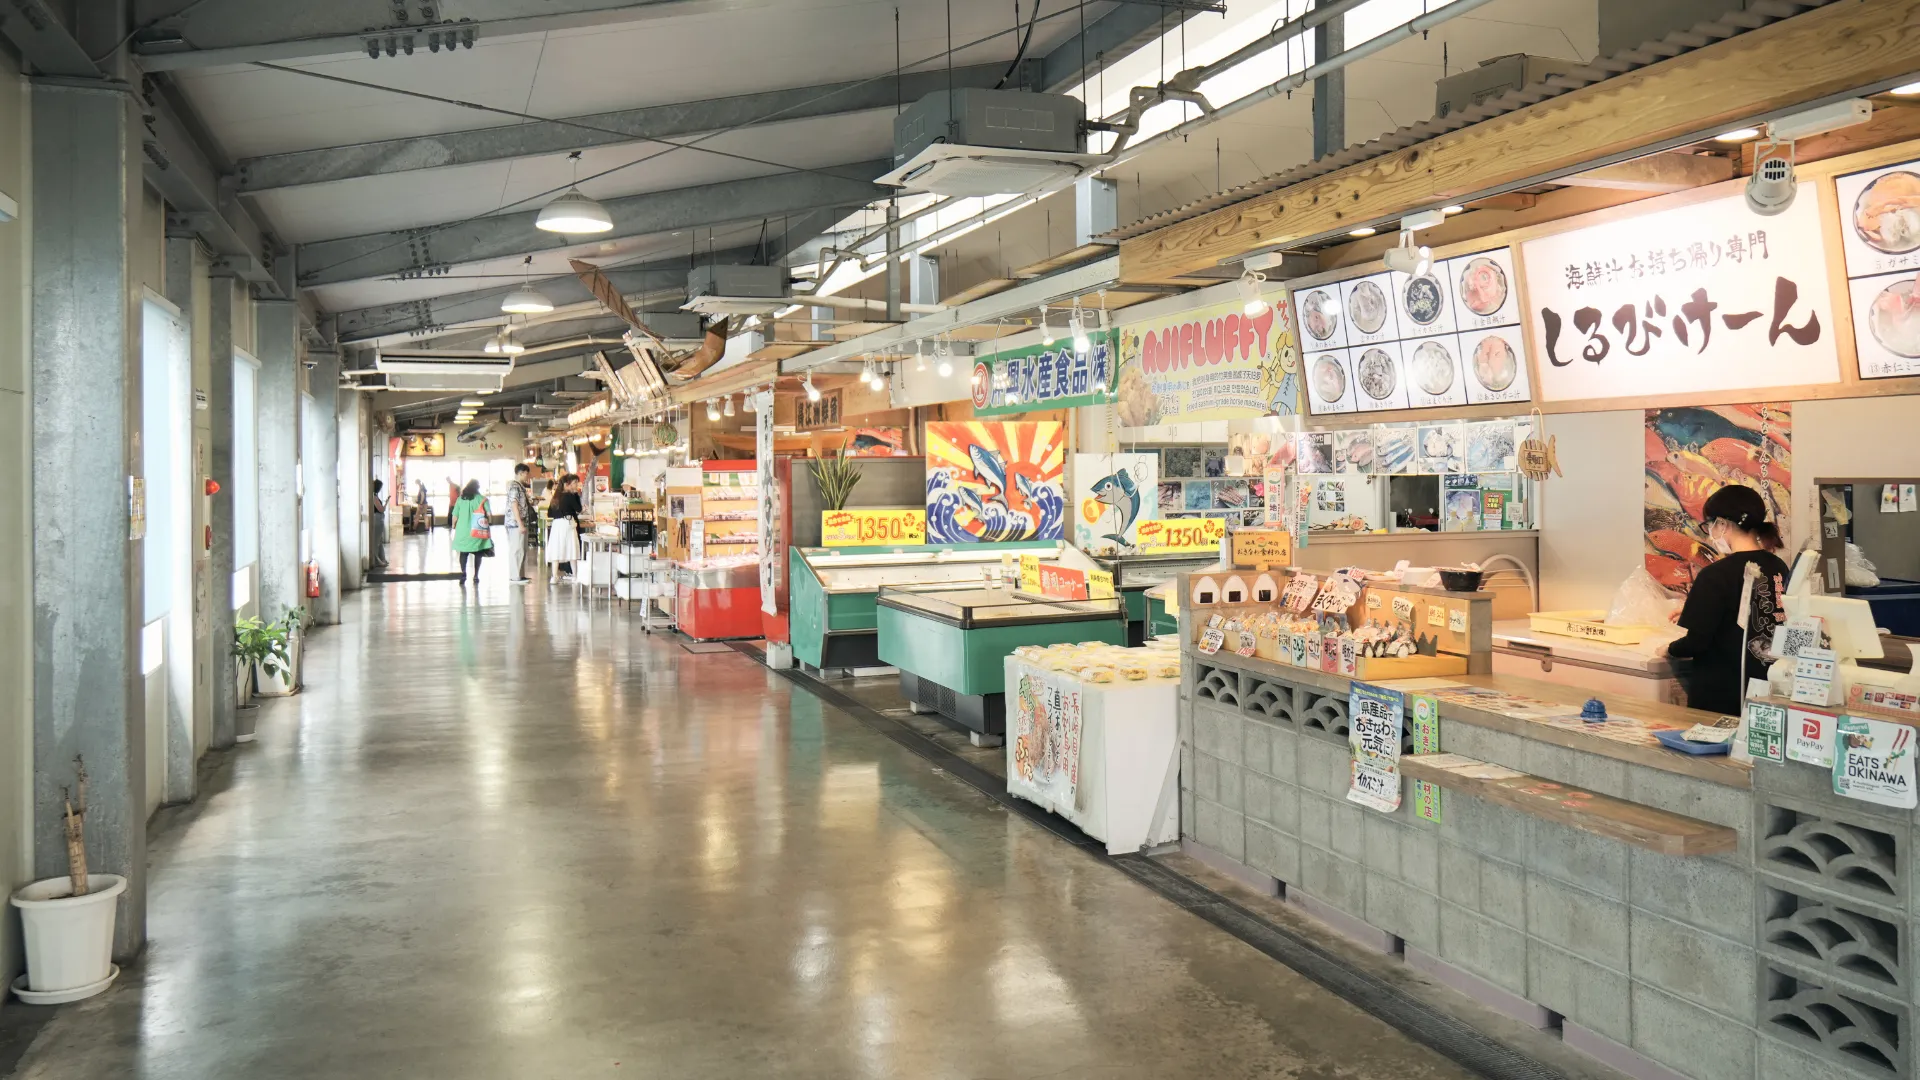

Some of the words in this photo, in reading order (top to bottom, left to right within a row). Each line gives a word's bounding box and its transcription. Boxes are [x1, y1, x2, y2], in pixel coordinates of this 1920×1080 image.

[1565, 229, 1769, 290] 海鮮汁お持ち帰り専門
[1541, 276, 1821, 367] しるびけーん
[1142, 305, 1274, 375] AJIFLUFFY
[1308, 638, 1320, 653] さけ
[1796, 738, 1825, 752] PayPay
[1848, 753, 1879, 769] EATS
[1848, 765, 1907, 786] OKINAWA
